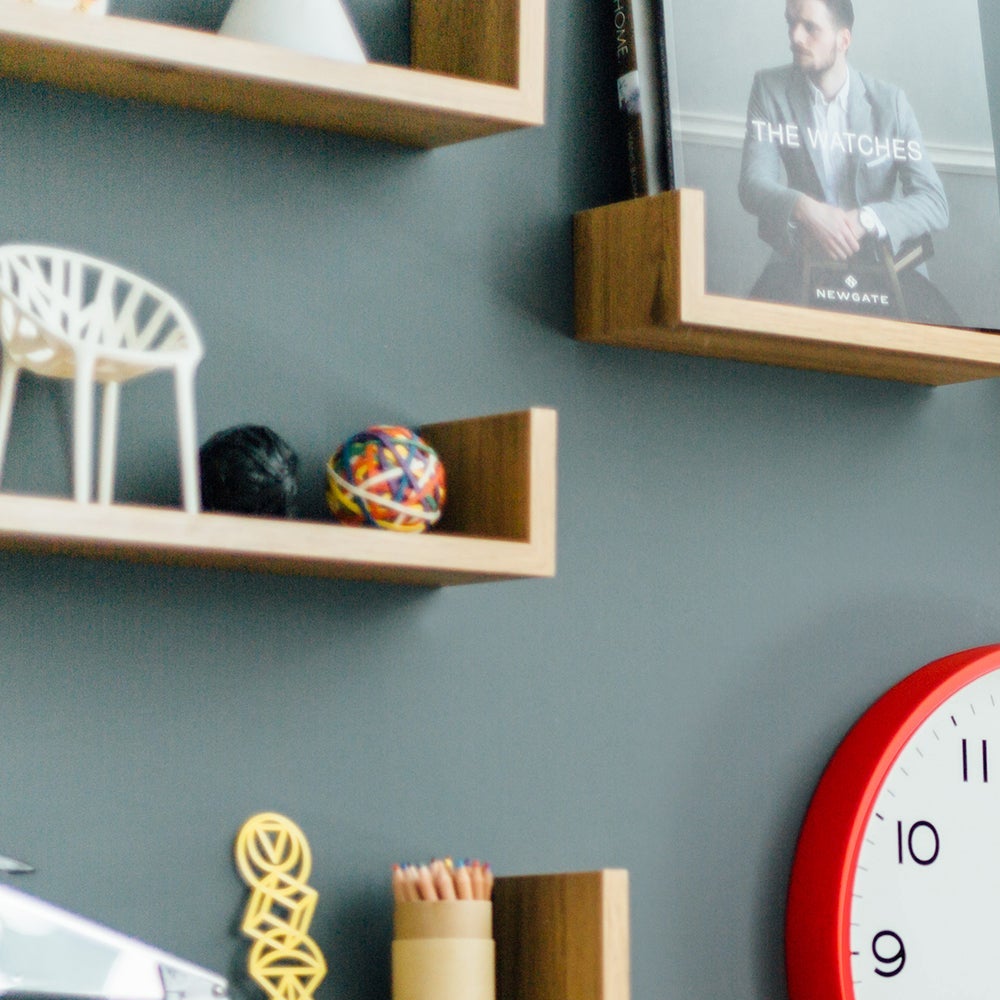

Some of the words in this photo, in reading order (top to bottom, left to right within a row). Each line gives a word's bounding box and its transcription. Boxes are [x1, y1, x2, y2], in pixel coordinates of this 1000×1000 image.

[752, 120, 800, 148] THE
[807, 127, 922, 161] WATCHES
[816, 288, 889, 304] NEWGATE
[962, 739, 987, 782] 11
[898, 821, 939, 865] 10
[872, 930, 906, 977] 9
